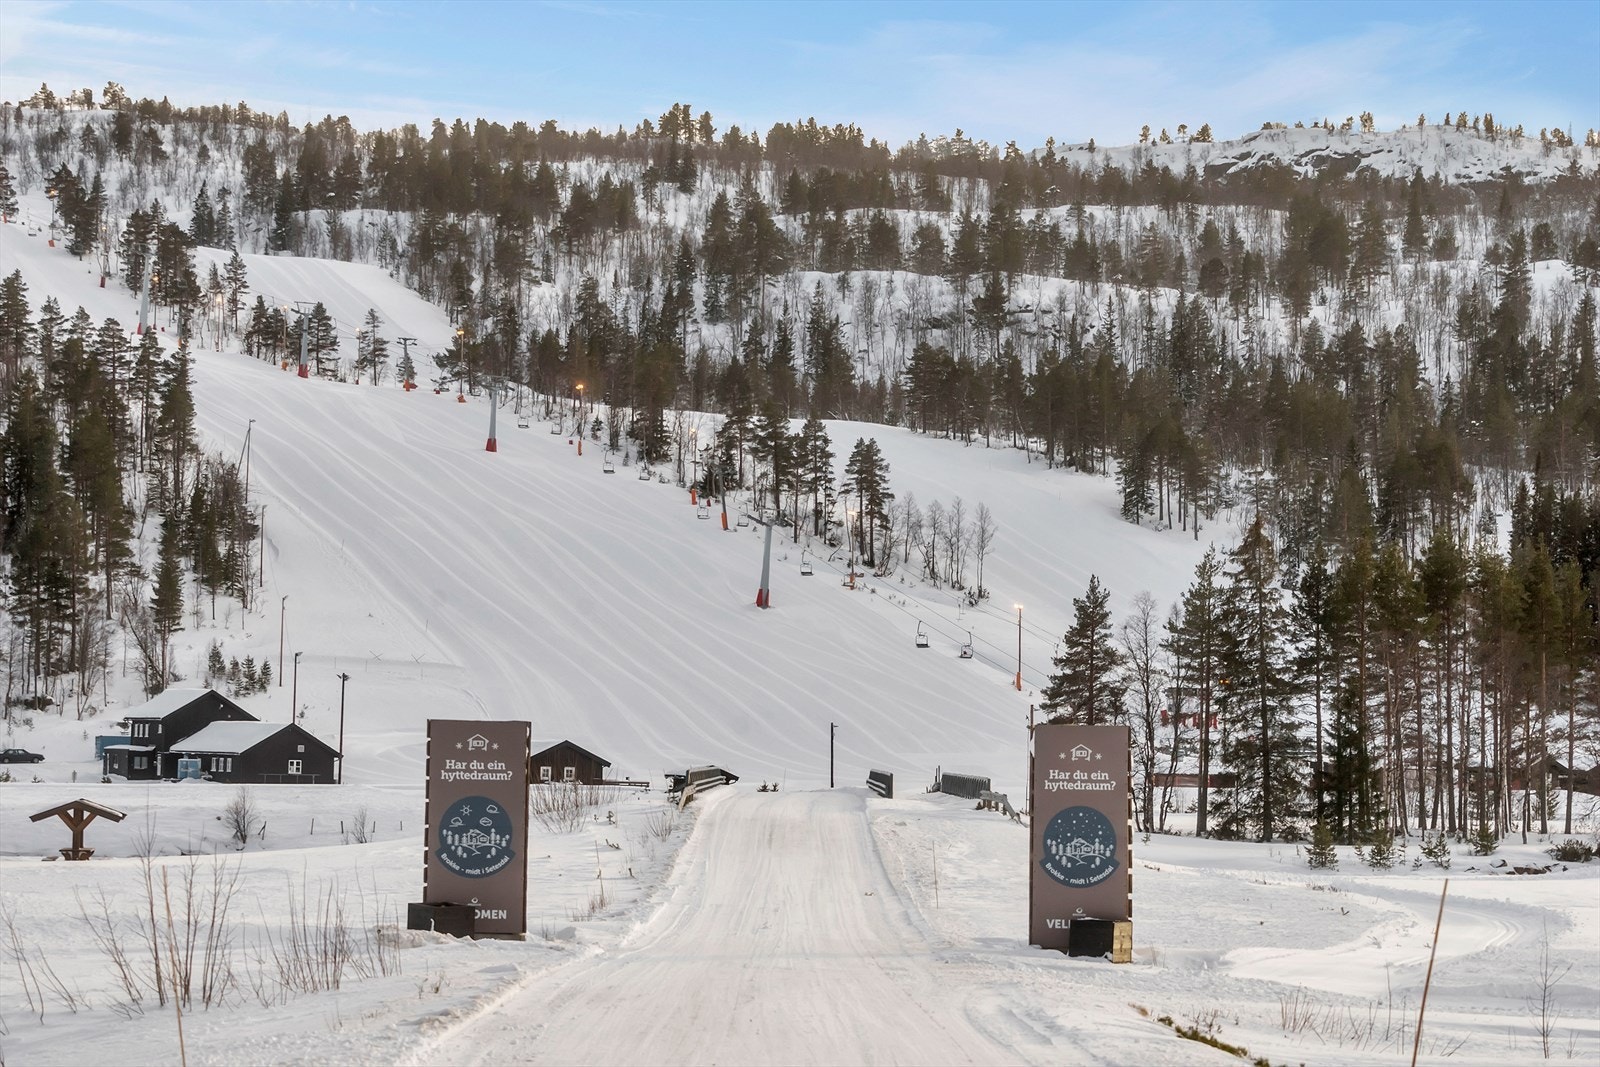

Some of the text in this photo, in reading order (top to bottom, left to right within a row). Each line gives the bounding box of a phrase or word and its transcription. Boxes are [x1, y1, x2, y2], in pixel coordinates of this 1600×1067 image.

[445, 759, 506, 770] Har du ein
[440, 769, 513, 782] hyttedraum?
[1048, 769, 1109, 780] Har du ein
[1044, 779, 1117, 792] hyttedraum?
[440, 852, 460, 871] Brokke
[484, 855, 510, 874] Setesdal
[1045, 862, 1065, 881] Brokke
[1089, 864, 1114, 883] Setesdal
[474, 909, 507, 920] OMEN
[1046, 918, 1071, 929] VEL
